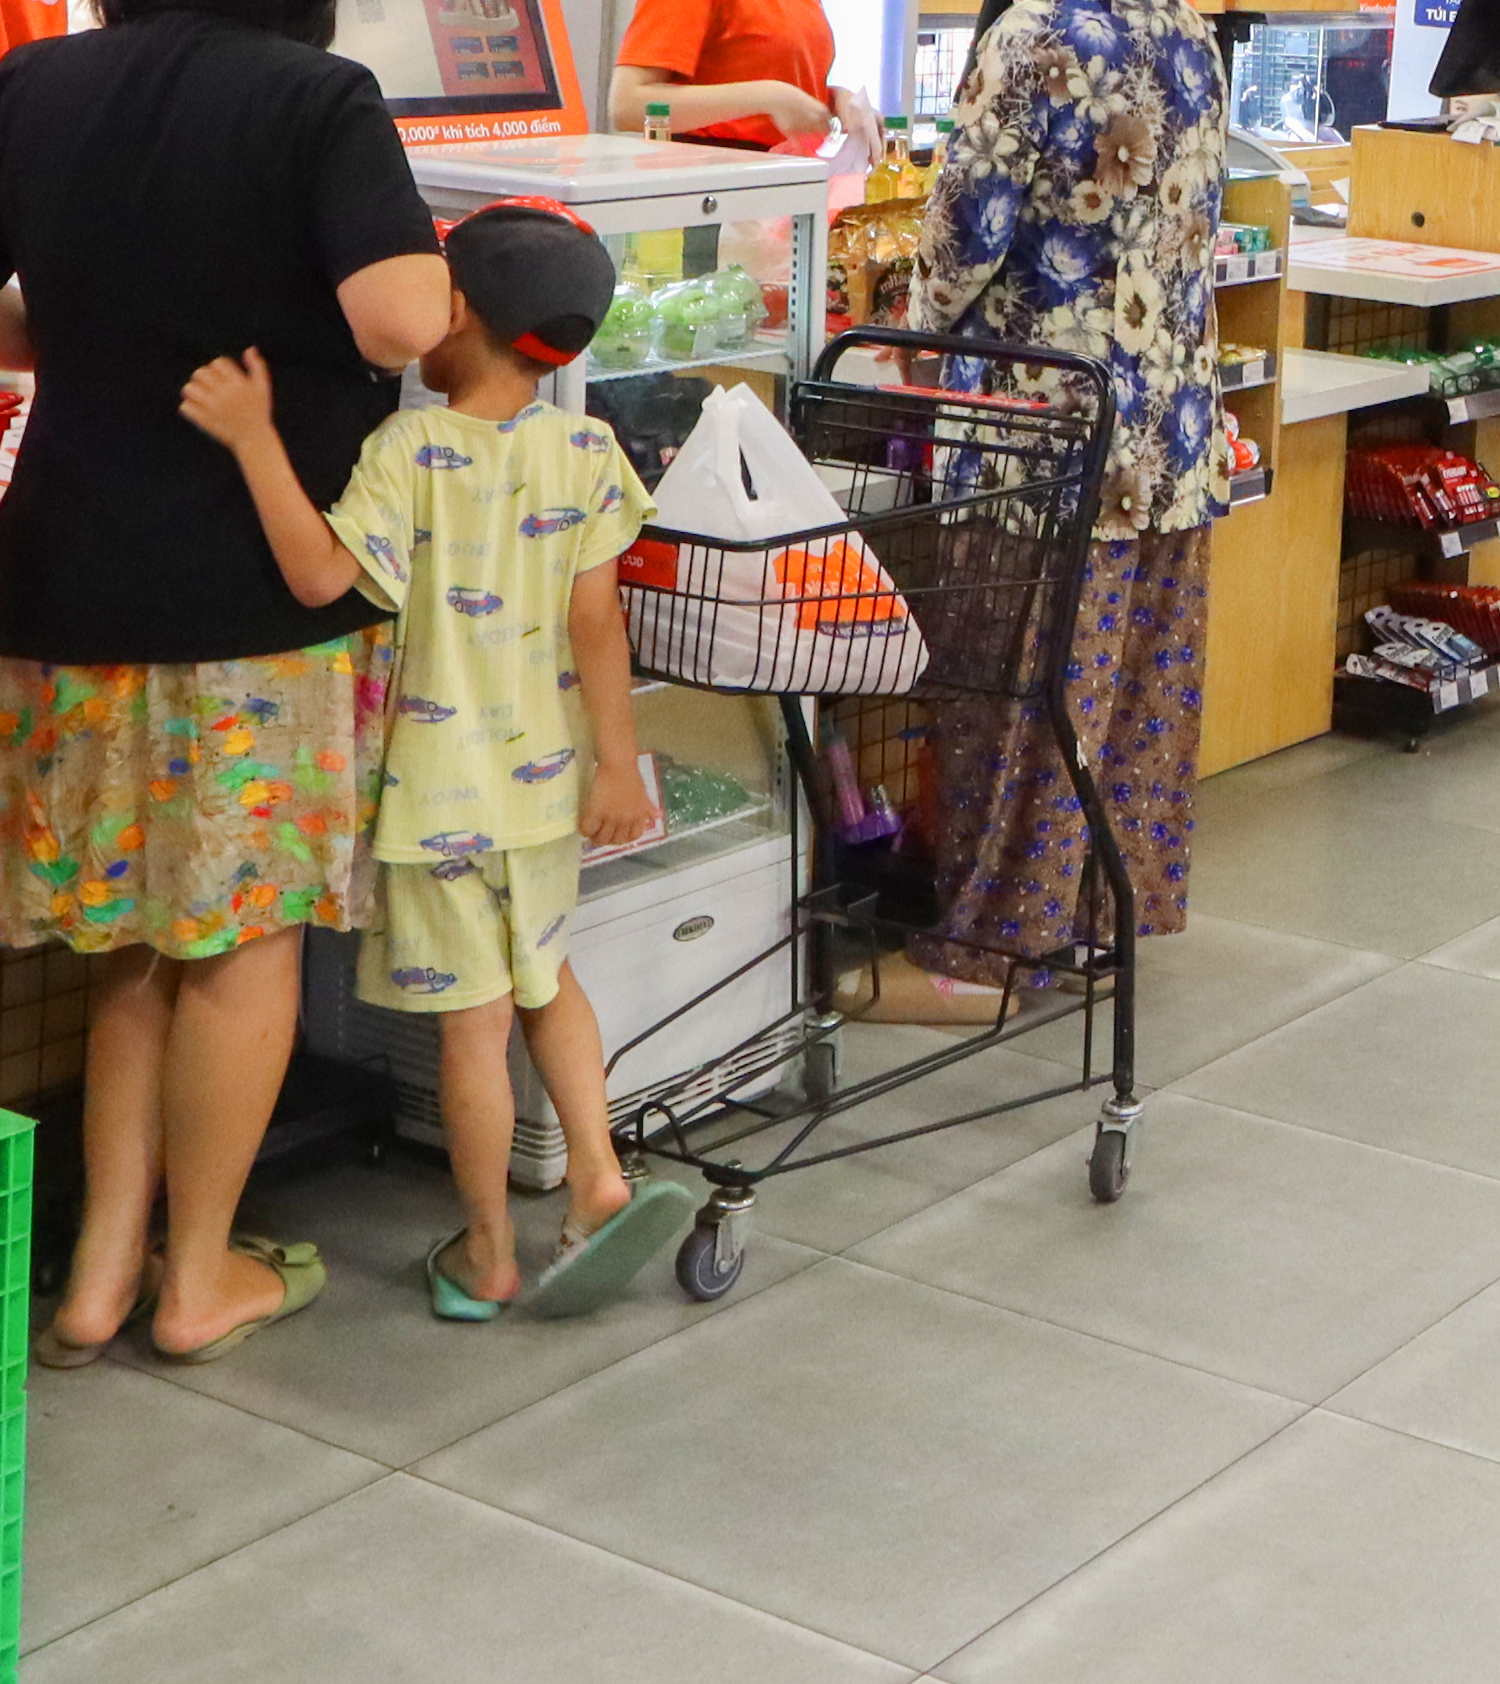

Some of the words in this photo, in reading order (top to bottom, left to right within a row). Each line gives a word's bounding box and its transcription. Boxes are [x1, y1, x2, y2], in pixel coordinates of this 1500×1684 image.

[1426, 6, 1446, 21] TÚI
[442, 123, 462, 139] khi
[466, 121, 489, 137] tích
[492, 120, 528, 135] 4,000
[530, 117, 561, 133] điểm
